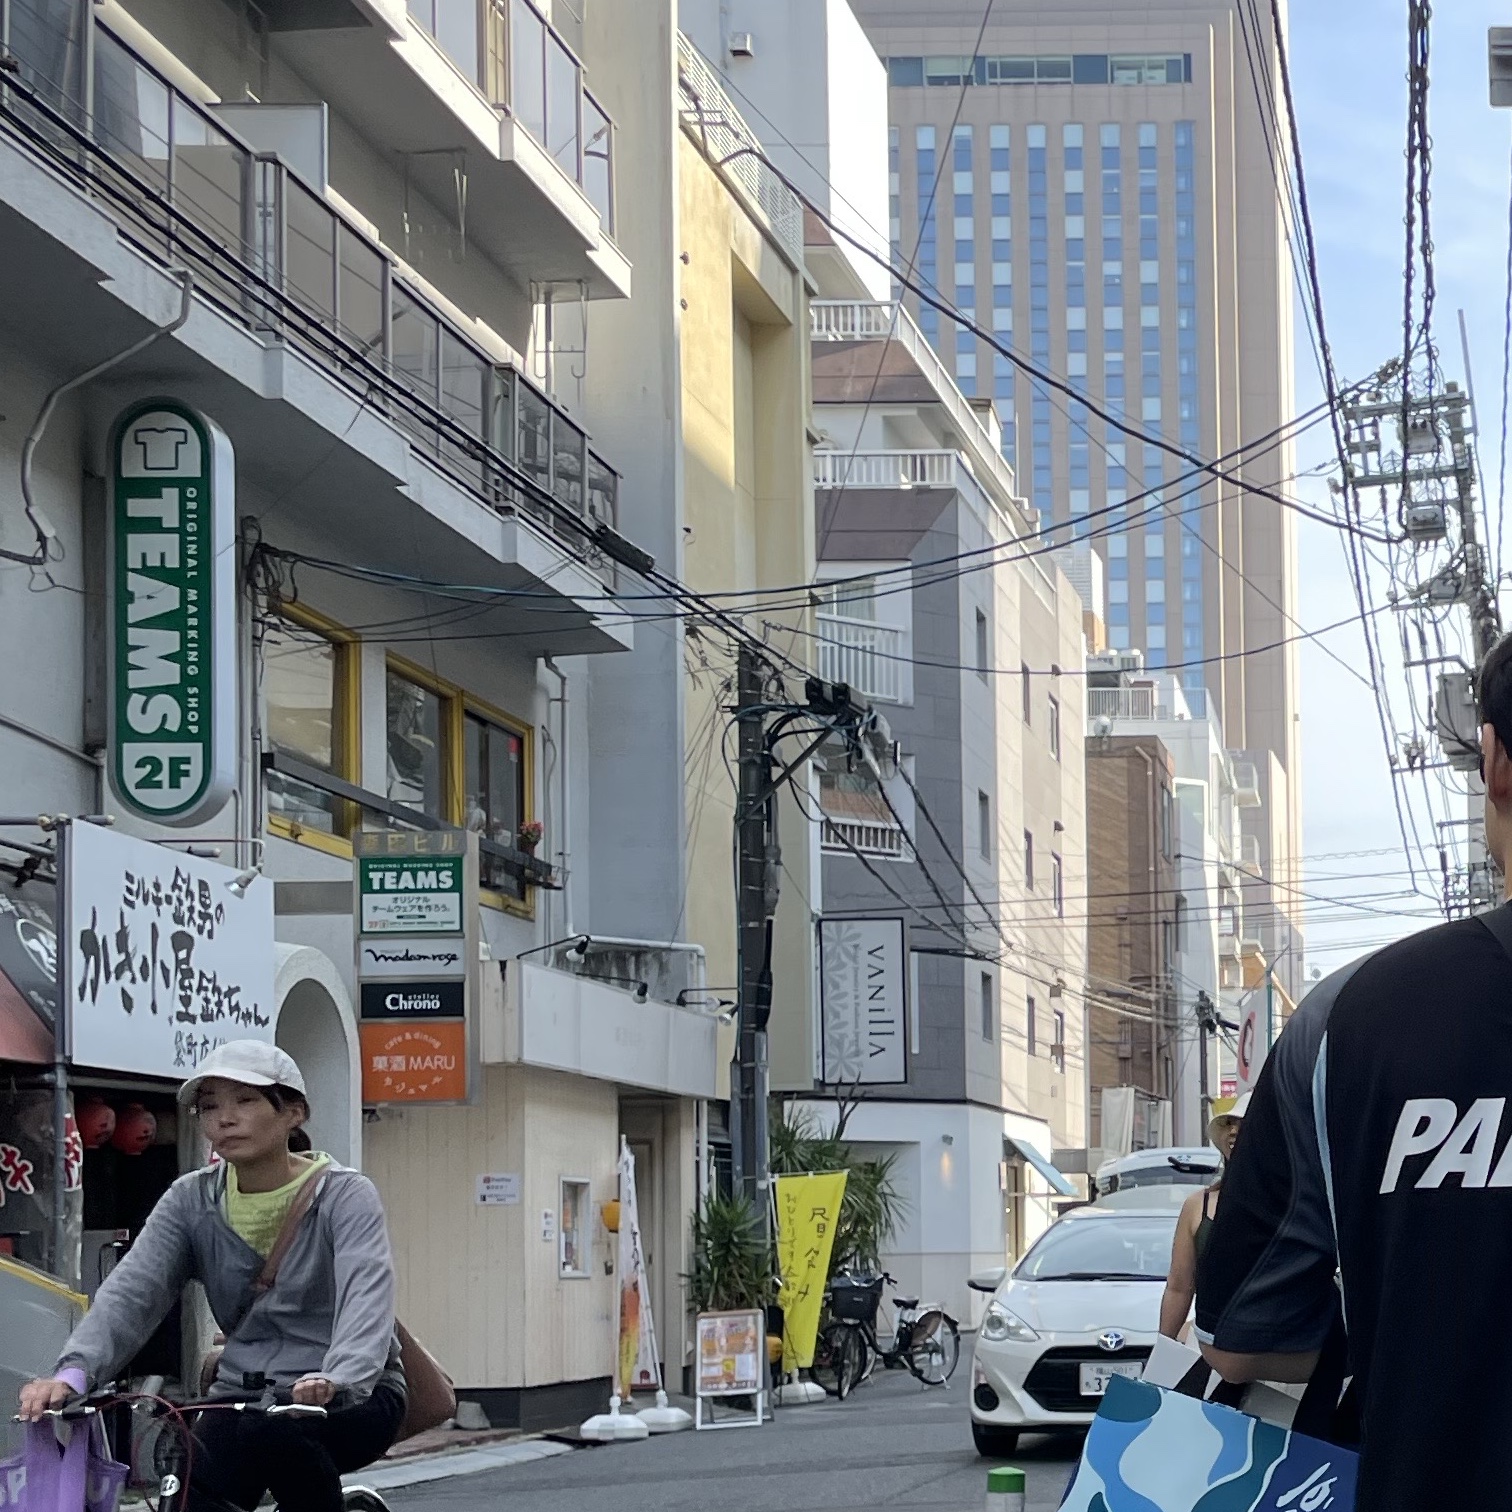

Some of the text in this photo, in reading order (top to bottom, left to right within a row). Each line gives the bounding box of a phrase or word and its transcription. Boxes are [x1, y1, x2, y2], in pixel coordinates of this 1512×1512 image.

[126, 487, 182, 734] TEAMS
[186, 487, 199, 734] ORIGINAL MARKING SHOP
[134, 756, 192, 789] 2F
[368, 870, 454, 890] TEAMS
[385, 993, 441, 1010] Chrono
[409, 1055, 456, 1071] MARU
